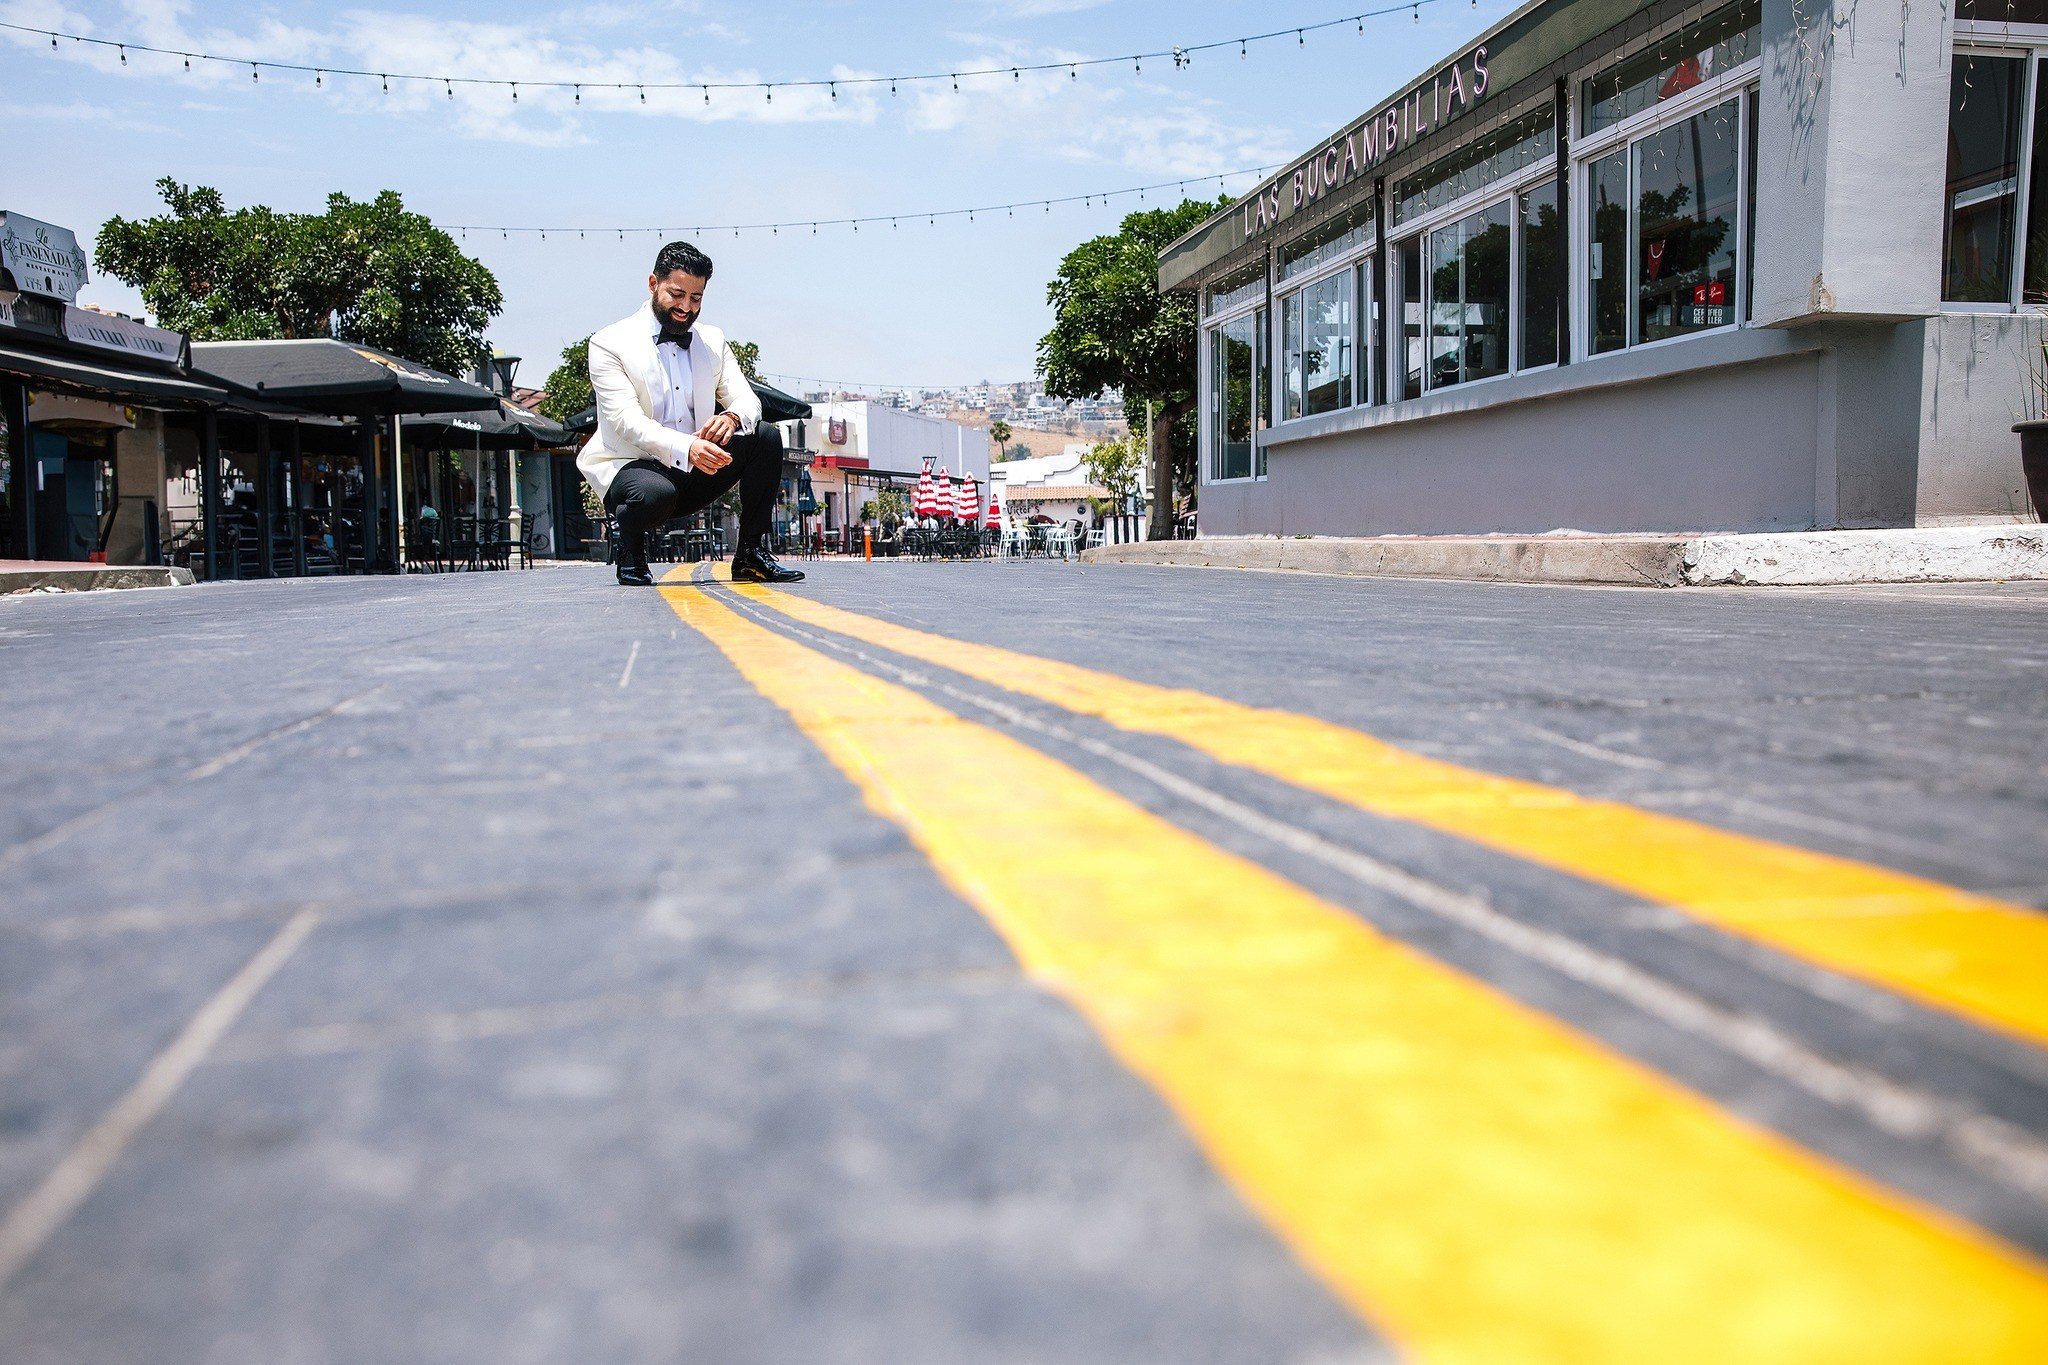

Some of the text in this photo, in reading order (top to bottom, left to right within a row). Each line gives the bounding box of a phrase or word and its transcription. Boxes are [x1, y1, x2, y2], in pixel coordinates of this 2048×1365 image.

[1244, 44, 1489, 238] LAS BUGAMBILIAS
[35, 227, 52, 250] La
[19, 242, 72, 268] ENSENADA
[26, 262, 69, 277] RESTAURANT
[1693, 308, 1723, 316] CERIFIED
[1693, 316, 1723, 325] RESLLER
[452, 418, 482, 431] Modelo
